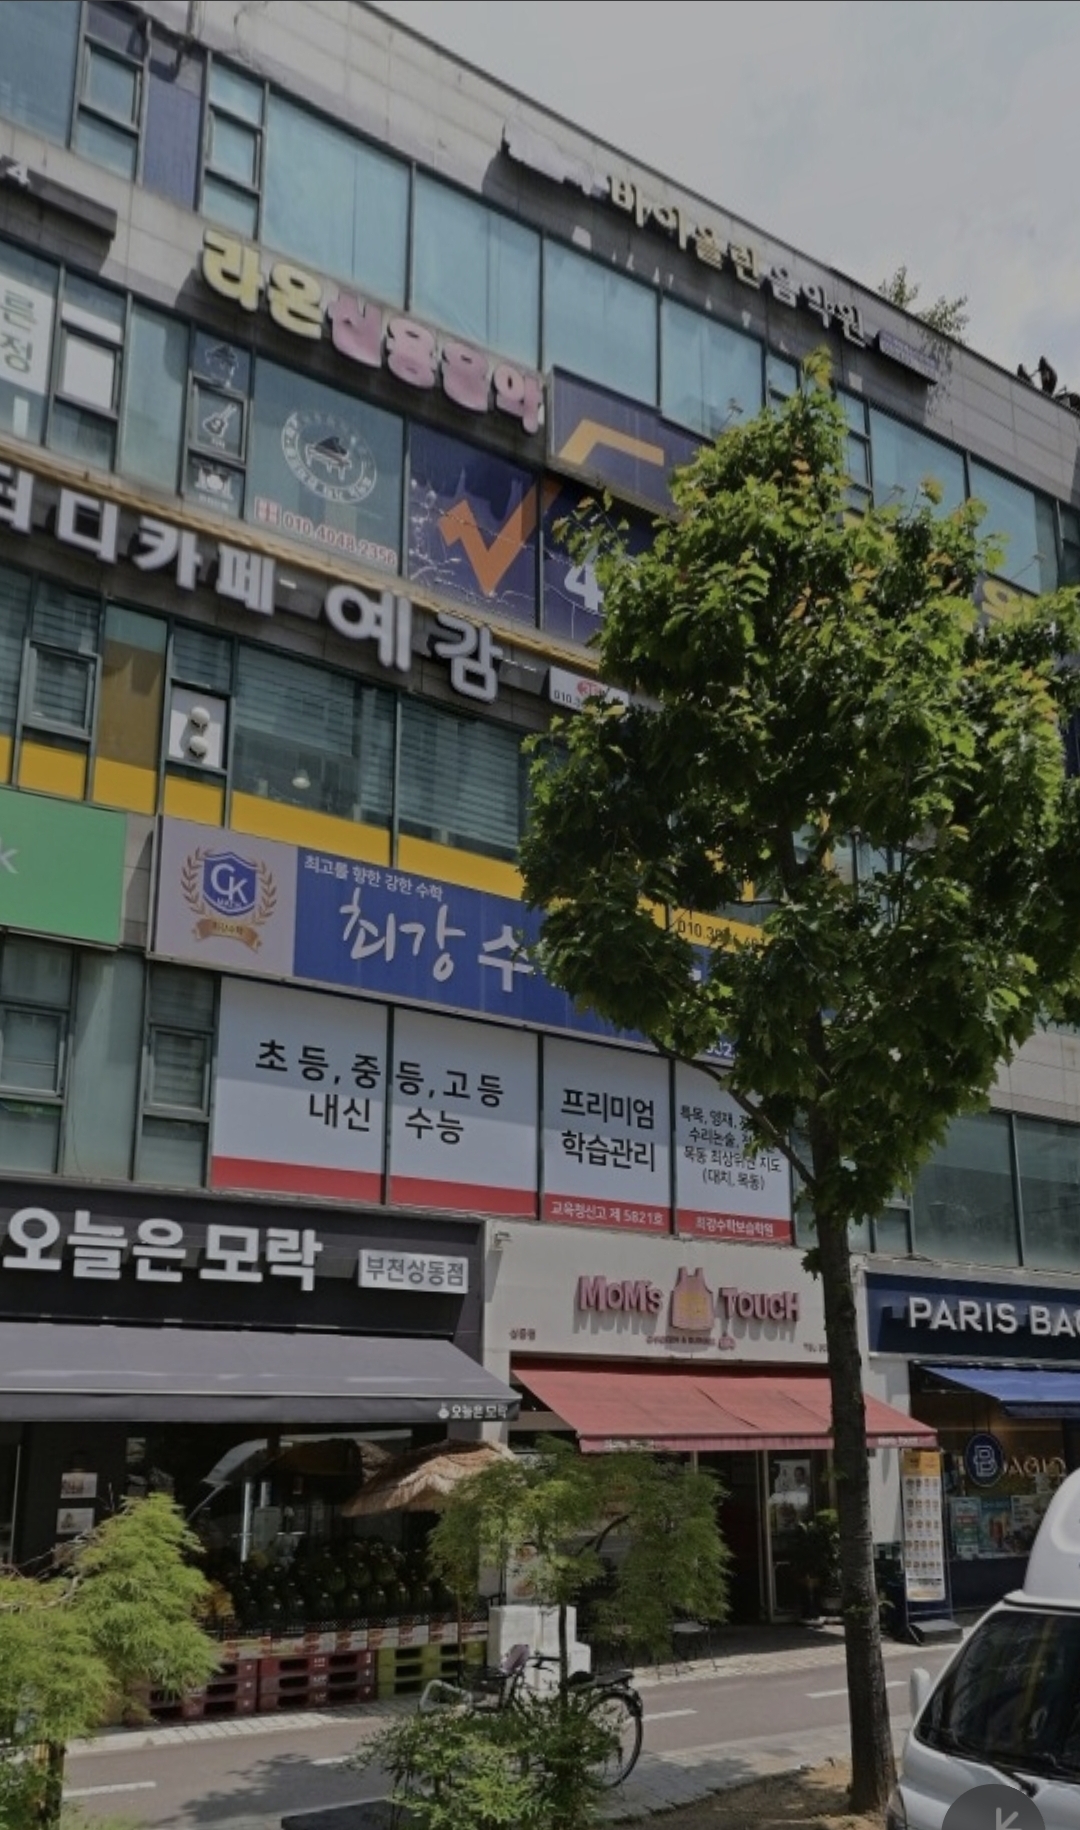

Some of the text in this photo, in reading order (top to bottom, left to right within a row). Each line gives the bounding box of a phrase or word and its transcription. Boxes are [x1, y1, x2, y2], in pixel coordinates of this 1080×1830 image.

[325, 585, 503, 703] 예감
[304, 854, 443, 902] 최고를 향한 강한 수학
[339, 887, 466, 982] 최강
[309, 1093, 464, 1145] 내신 수능
[561, 1088, 654, 1129] 프리미엄
[561, 1129, 654, 1172] 학습관리
[760, 1157, 782, 1173] 지도
[3, 1207, 324, 1291] 오늘은 모락
[365, 1255, 465, 1287] 부천상동점
[909, 1296, 1018, 1335] PARIS
